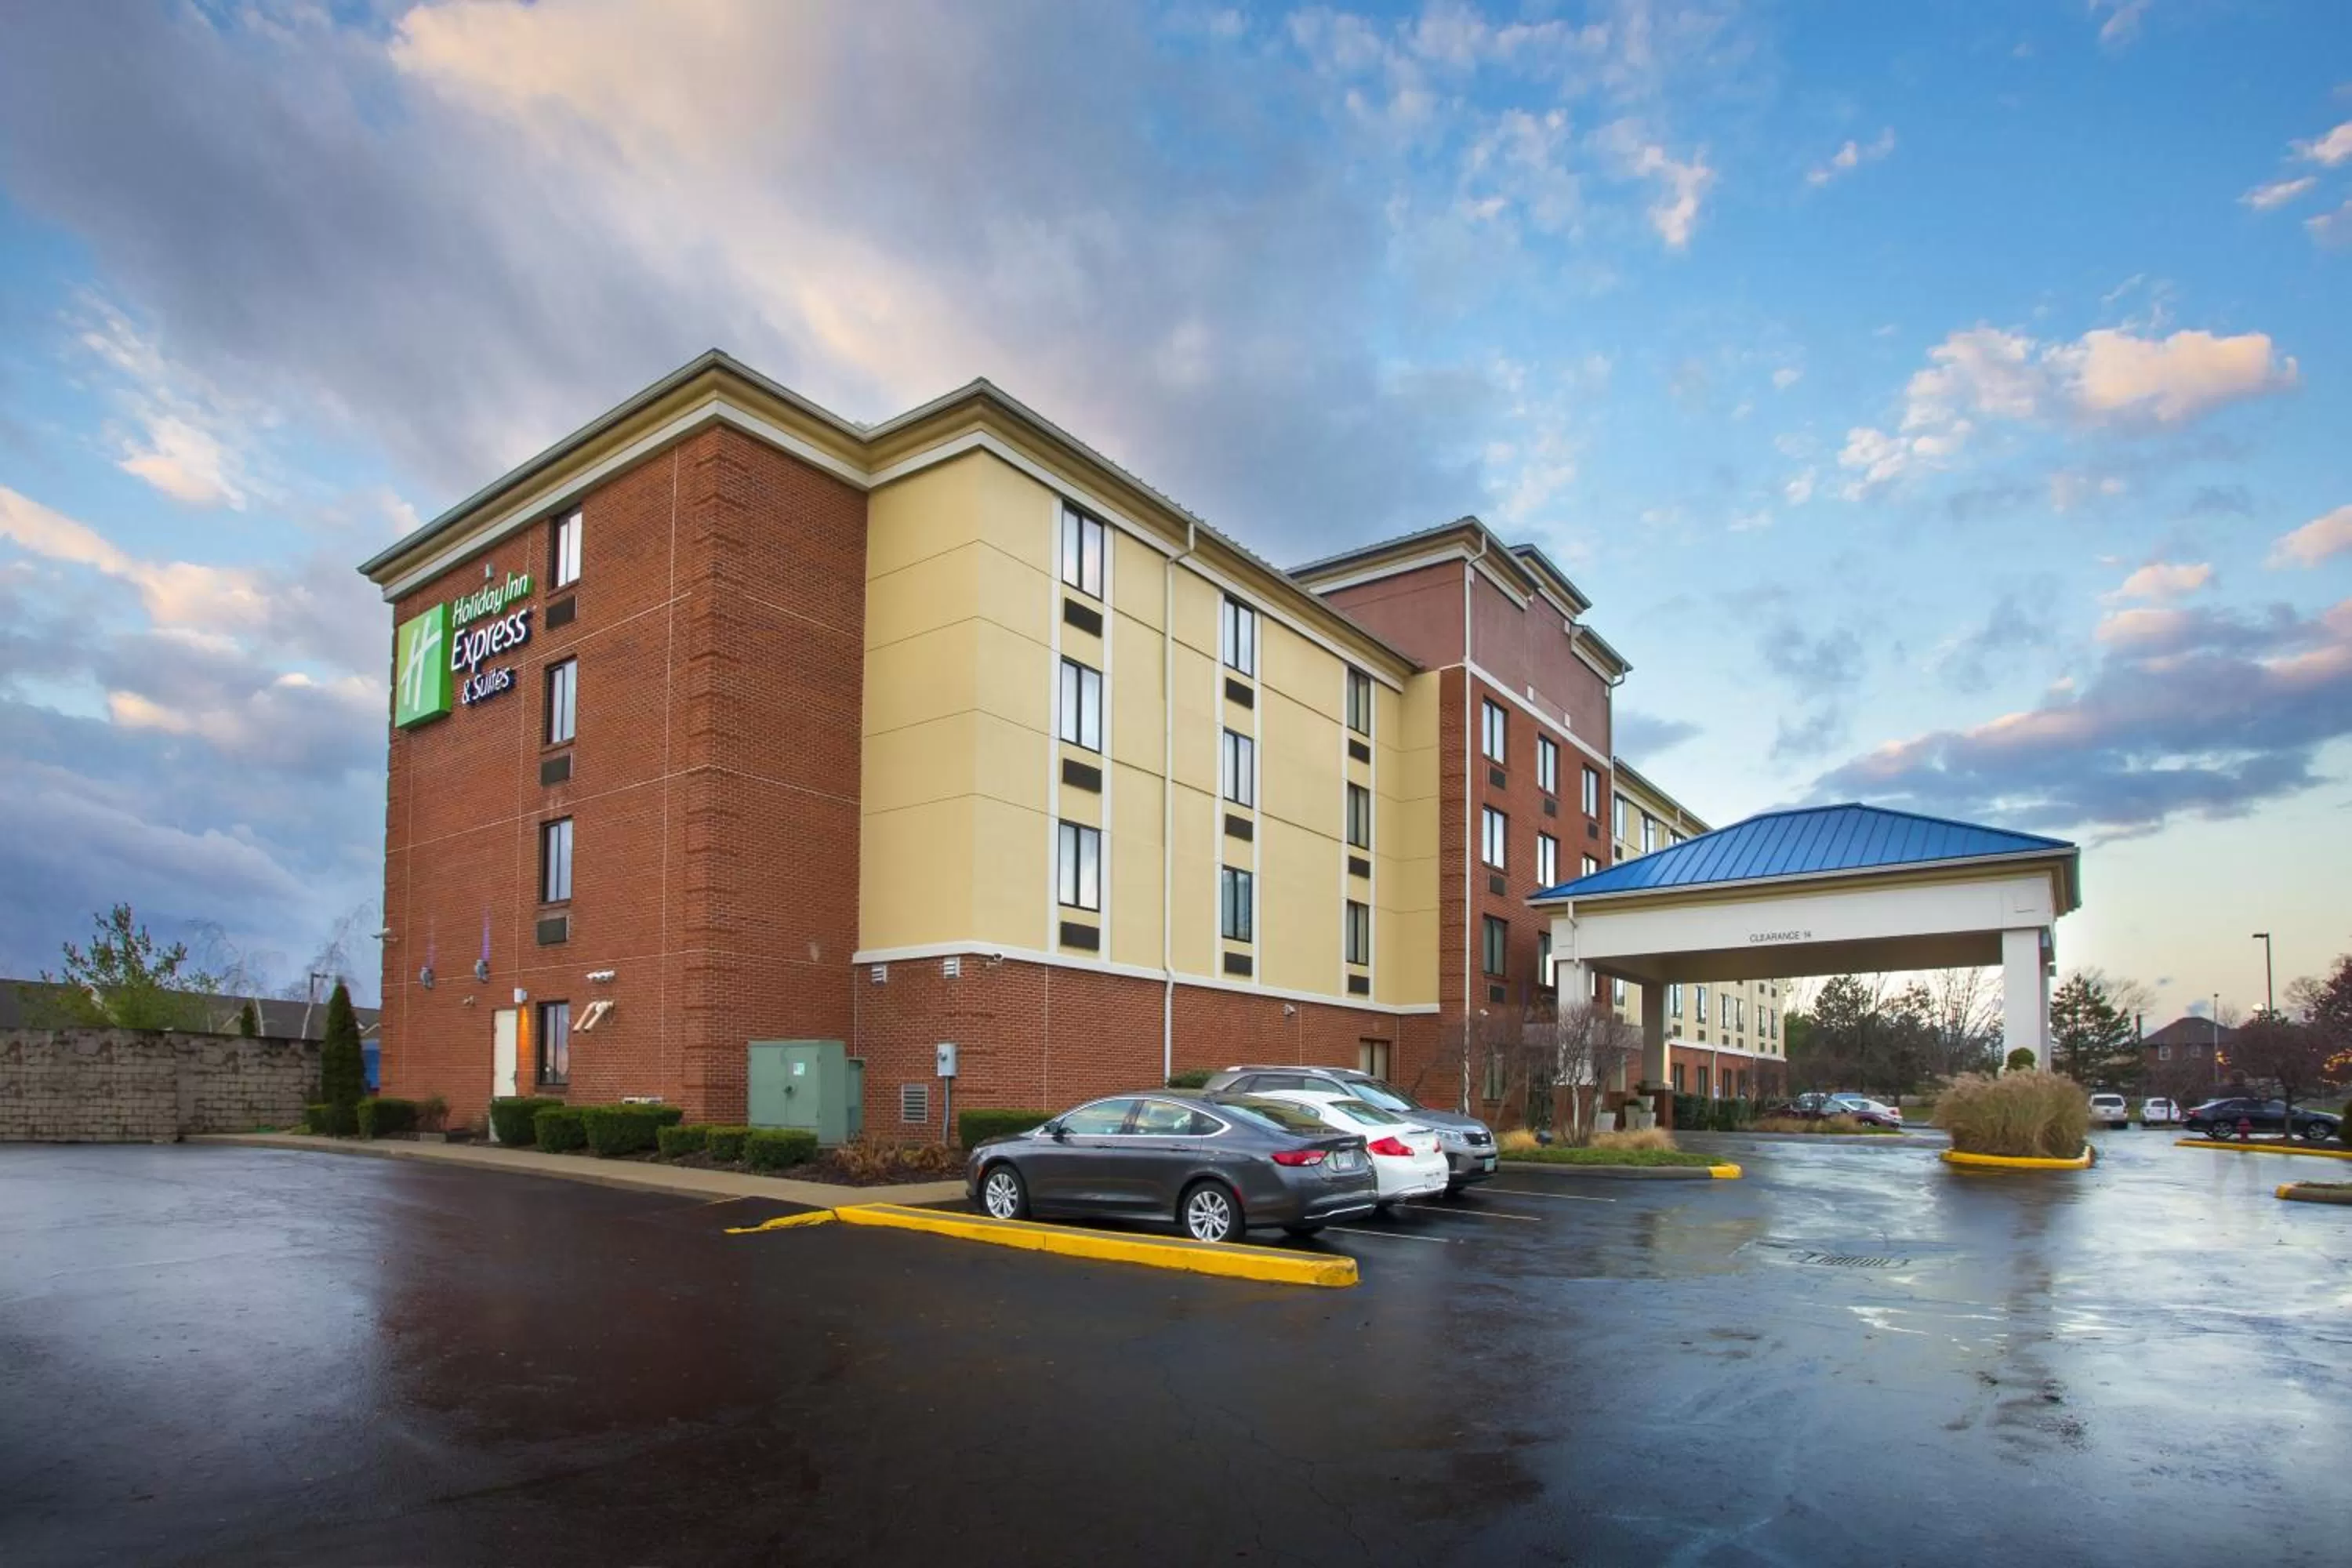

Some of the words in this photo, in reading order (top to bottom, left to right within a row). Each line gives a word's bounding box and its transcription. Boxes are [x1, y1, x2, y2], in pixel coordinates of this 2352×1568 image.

[452, 585, 506, 627] Holiday
[505, 572, 528, 602] Inn
[451, 608, 528, 673] Express
[462, 680, 471, 705] &
[471, 667, 510, 701] Suites
[1749, 931, 1800, 943] CLEARANCE
